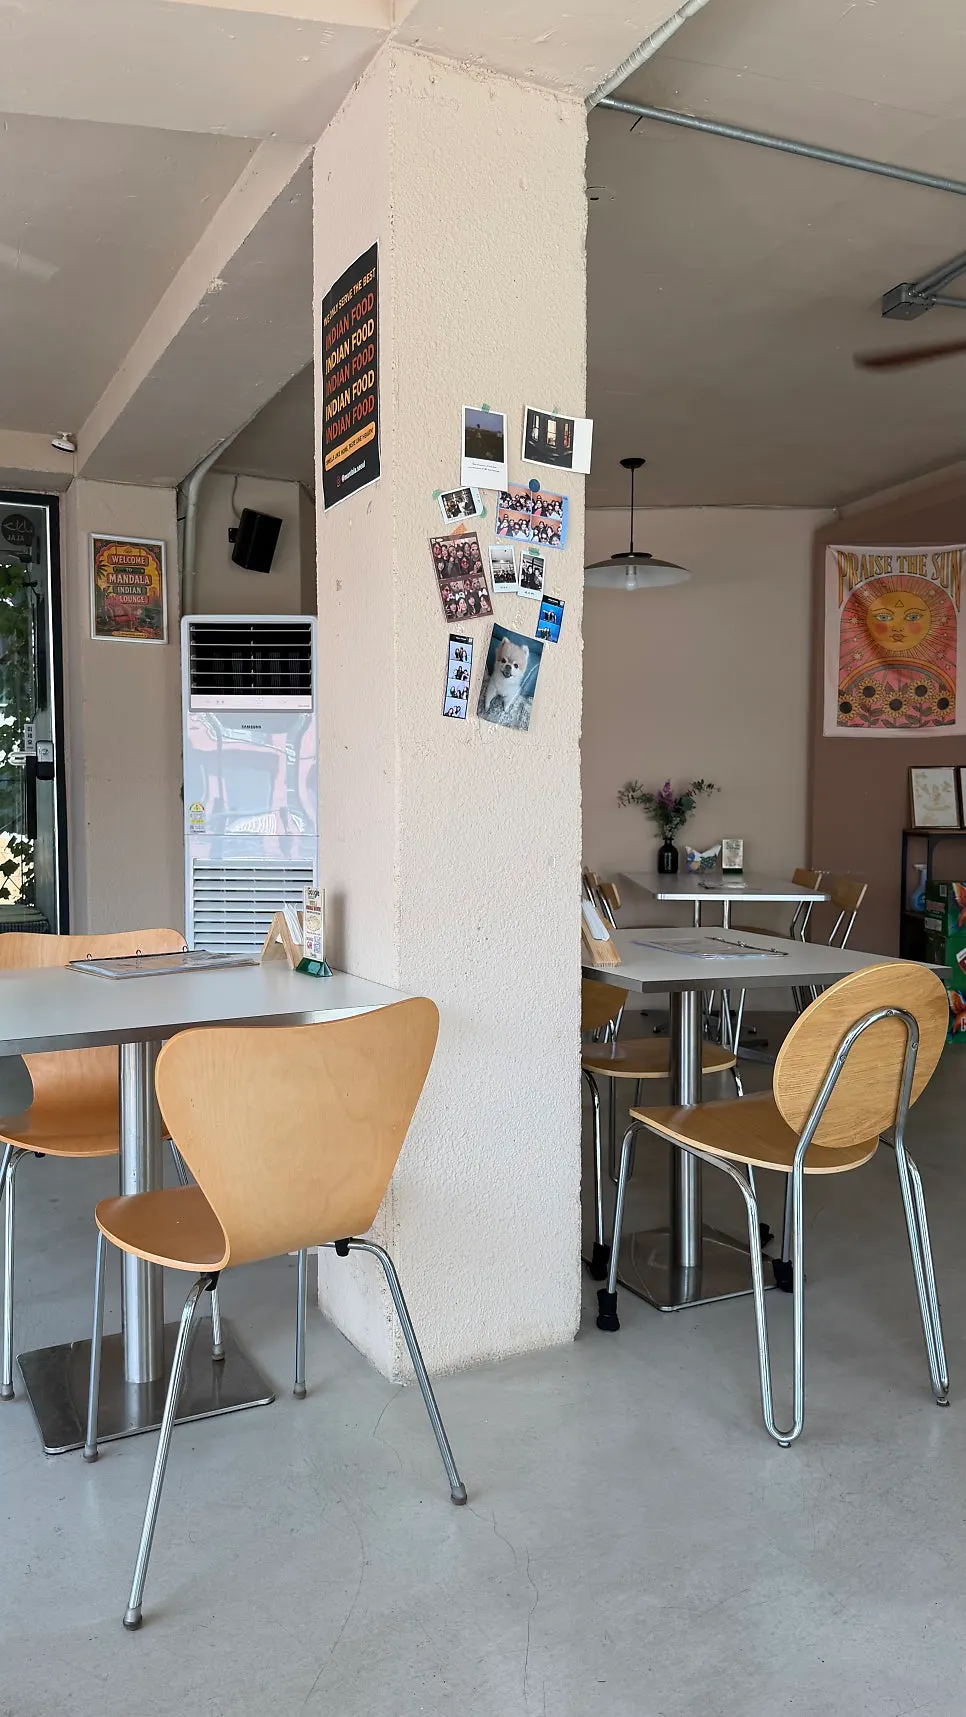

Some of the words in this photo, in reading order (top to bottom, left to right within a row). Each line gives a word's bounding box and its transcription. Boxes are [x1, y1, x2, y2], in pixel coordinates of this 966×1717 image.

[323, 314, 330, 327] WE
[329, 302, 339, 318] ONLY
[338, 288, 353, 309] SERVE
[352, 279, 362, 296] THE
[362, 267, 376, 288] BEST
[325, 313, 350, 352] INDIAN
[351, 292, 375, 326] FOOD
[325, 338, 350, 376] INDIAN
[351, 318, 375, 351] FOOD
[325, 362, 350, 398] INDIAN
[351, 343, 375, 376] FOOD
[325, 387, 351, 422] INDIAN
[352, 369, 375, 401] FOOD
[325, 411, 351, 445] INDIAN
[352, 394, 375, 425] FOOD
[109, 572, 151, 585] MANDALA
[111, 555, 146, 565] WELCOME
[836, 550, 893, 609] PRAISE
[896, 553, 928, 577] THE
[931, 548, 963, 613] SUN
[117, 586, 142, 594] INDIAN
[119, 595, 145, 603] LOUNGE
